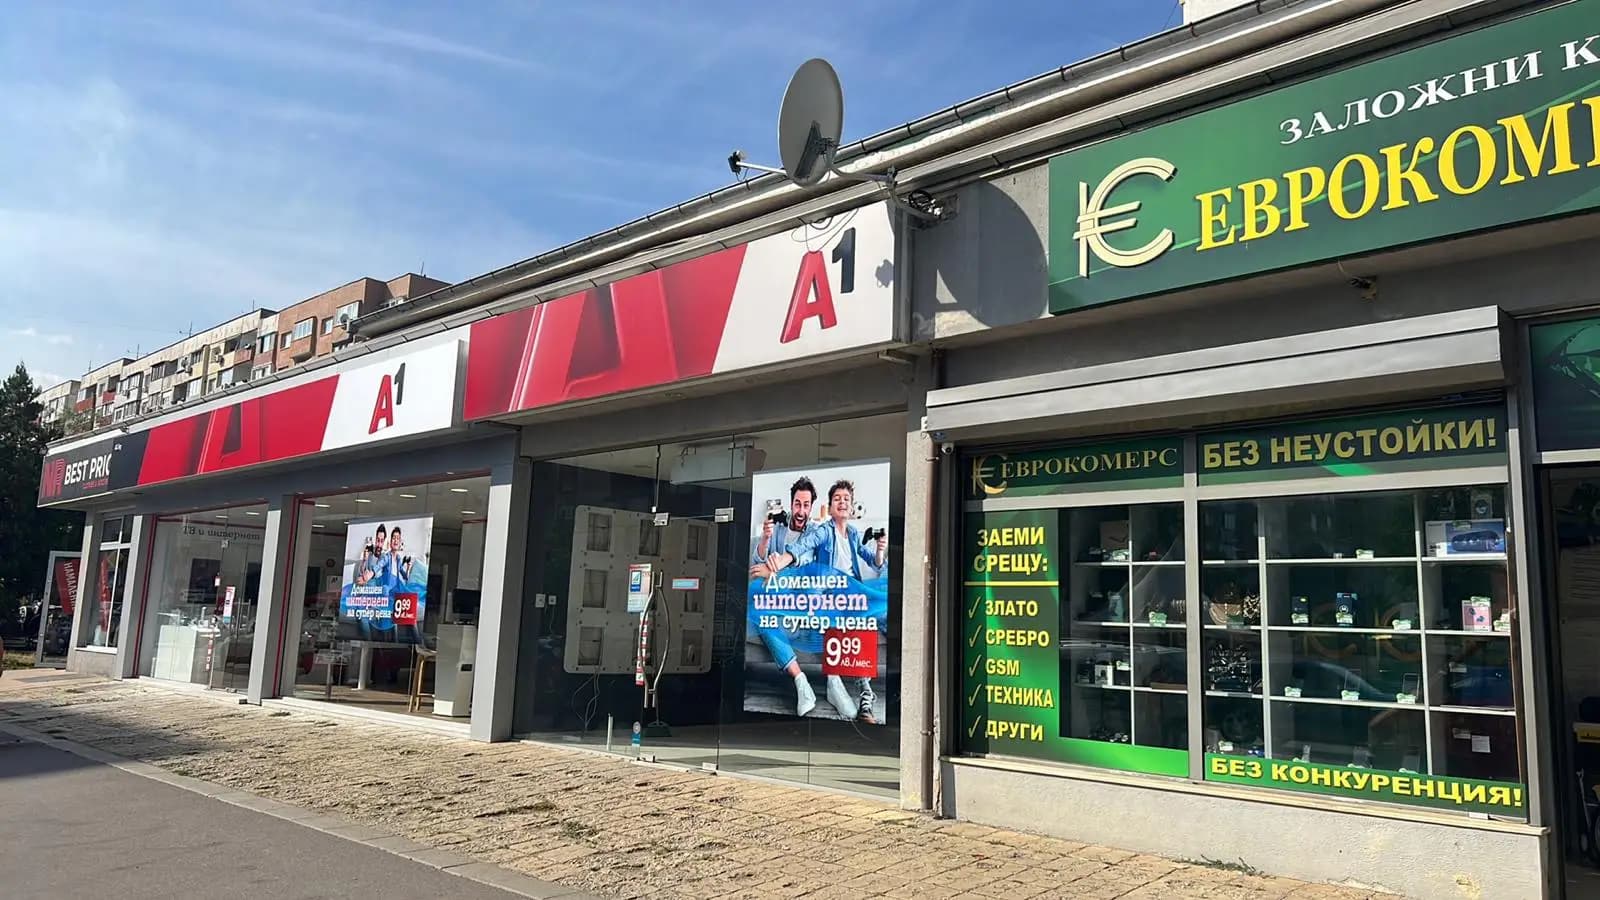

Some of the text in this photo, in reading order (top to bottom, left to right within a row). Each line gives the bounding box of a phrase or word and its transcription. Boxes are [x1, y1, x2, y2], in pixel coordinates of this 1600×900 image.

[1279, 50, 1543, 145] ЗАЛОЖНИ
[779, 226, 856, 344] A1
[368, 362, 406, 435] A1
[1203, 418, 1496, 468] БЕЗ НЕУСТОЙКИ!
[64, 460, 89, 485] BEST
[1000, 448, 1177, 479] ЕВРОКОМЕРС
[977, 527, 1044, 547] ЗАЕМИ
[974, 553, 1048, 575] СРЕЩУ:
[350, 585, 383, 596] Домашен
[765, 572, 849, 593] Домашен
[346, 597, 388, 609] интернет
[753, 593, 868, 616] интернет
[985, 600, 1039, 617] ЗЛАТО
[346, 609, 392, 620] на супер цена
[760, 615, 878, 633] на супер цена
[985, 628, 1050, 647] СРЕБРО
[840, 656, 873, 668] лв./мес.
[985, 658, 1019, 676] GSM
[985, 685, 1054, 708] ТЕХНИКА
[985, 720, 1043, 741] ДРУГИ
[1211, 757, 1523, 807] БЕЗ КОНКУРЕНЦИЯ!
